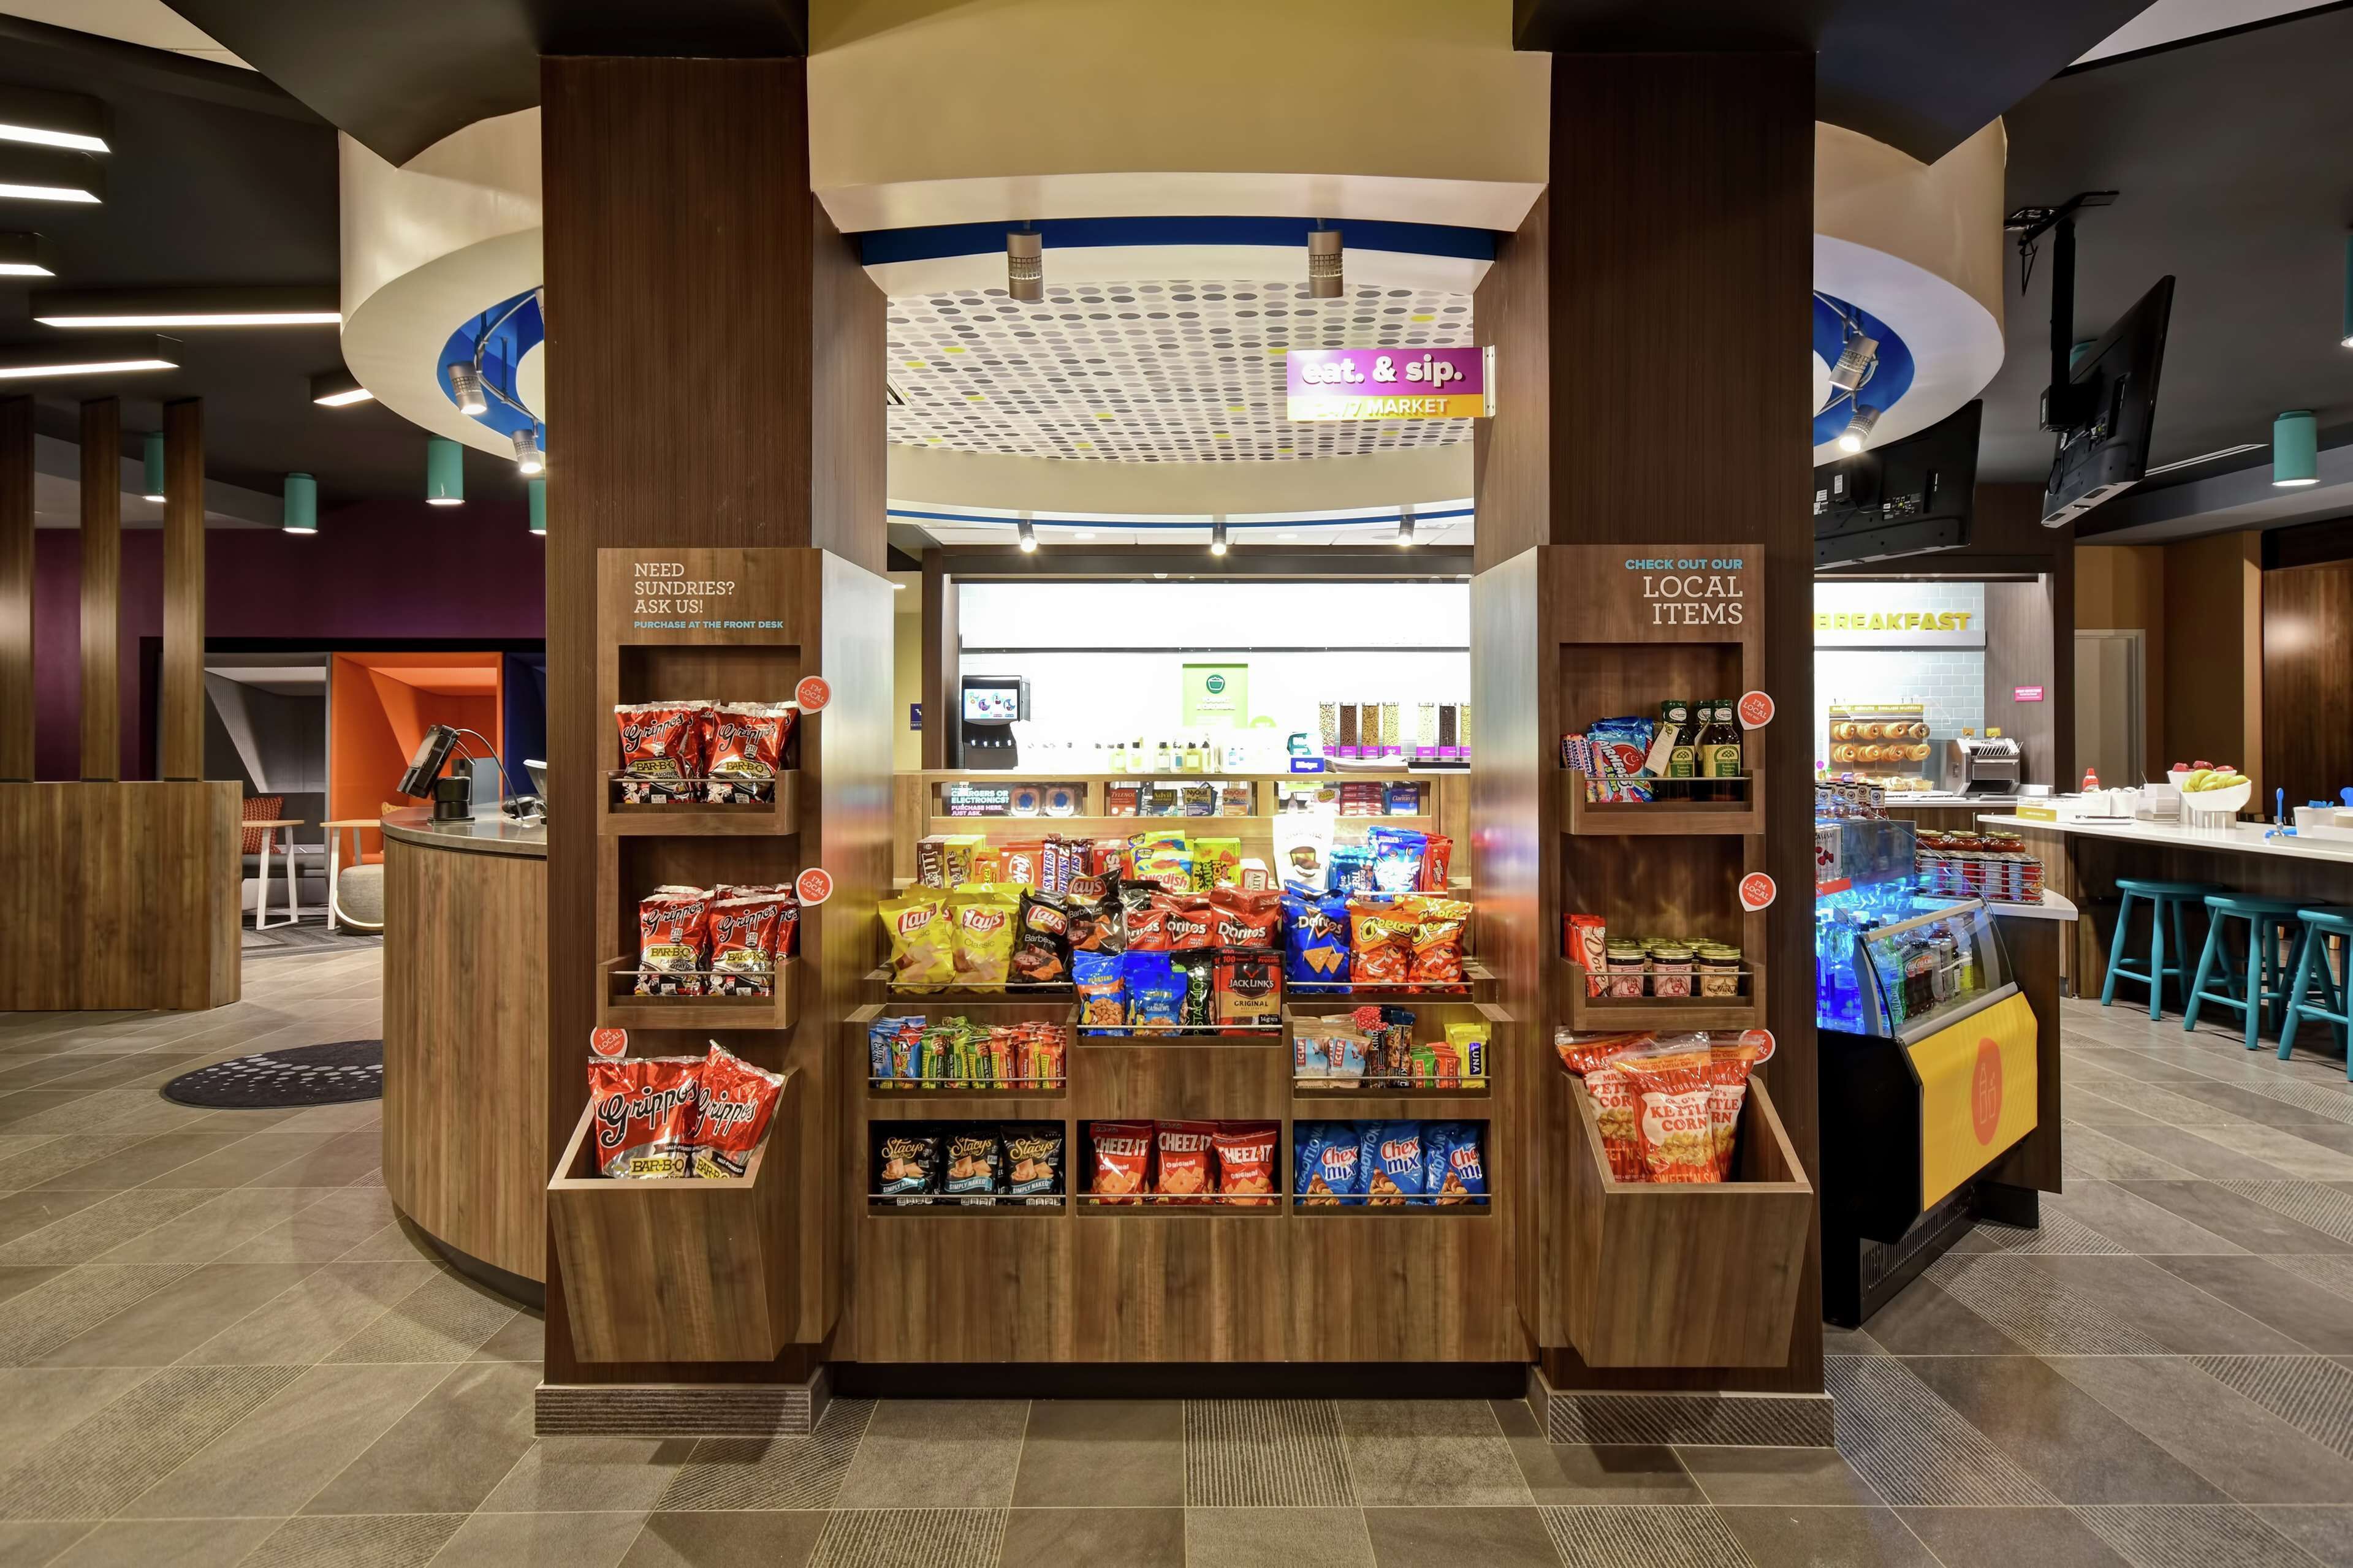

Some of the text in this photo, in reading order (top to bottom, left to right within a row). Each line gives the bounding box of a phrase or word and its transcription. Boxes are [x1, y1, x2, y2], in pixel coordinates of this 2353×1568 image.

[1302, 354, 1463, 387] eat. & sip.
[1368, 399, 1448, 414] MARKET
[634, 563, 685, 577] NEED
[1625, 559, 1743, 570] CHECK OUT OUR
[634, 581, 735, 595] SUNDRIES?
[1643, 576, 1743, 598] LOCAL
[634, 600, 703, 613] ASK US!
[1652, 603, 1743, 625] ITEMS
[1814, 612, 1971, 631] BREAKFAST
[801, 687, 824, 703] LOCAL
[810, 684, 823, 694] I'M
[1743, 702, 1766, 719] LOCAL
[1753, 699, 1765, 708] I'M
[636, 760, 677, 771] BAR-B-Q
[811, 876, 824, 886] I'M
[1138, 871, 1188, 888] Swedish
[1754, 881, 1766, 890] I'M
[801, 879, 825, 896] LOCAL
[1744, 884, 1768, 900] LOCAL
[643, 901, 704, 937] Grippo's
[718, 904, 778, 944] Grippo's
[1298, 915, 1343, 935] Doritos
[1218, 921, 1267, 939] Doritos
[1362, 917, 1413, 941] Cheetos
[964, 937, 995, 949] Classic
[651, 948, 691, 957] BAR-B-Q
[1229, 980, 1250, 988] JACK
[1192, 975, 1203, 1036] PSTACHIOS
[598, 1032, 622, 1050] LOCAL
[600, 1030, 612, 1040] I'M
[1589, 1083, 1629, 1094] KETT
[1600, 1095, 1632, 1108] COR
[1708, 1099, 1739, 1110] TTLE
[1662, 1118, 1708, 1132] CORN
[1712, 1113, 1731, 1123] RN
[881, 1137, 925, 1159] Stacy's
[951, 1136, 992, 1156] Stacy's
[1010, 1138, 1054, 1160] Stacy's
[1381, 1137, 1420, 1159] Chex
[1322, 1146, 1358, 1165] Chex
[1451, 1149, 1478, 1168] Che
[632, 1159, 685, 1172] BAR-B-Q
[1388, 1154, 1420, 1173] mix
[1459, 1163, 1482, 1178] mi
[1326, 1163, 1356, 1180] mix
[883, 1184, 900, 1193] SIMPLY
[968, 1179, 987, 1188] NAKED
[1013, 1180, 1049, 1194] SIMPLY NAKED
